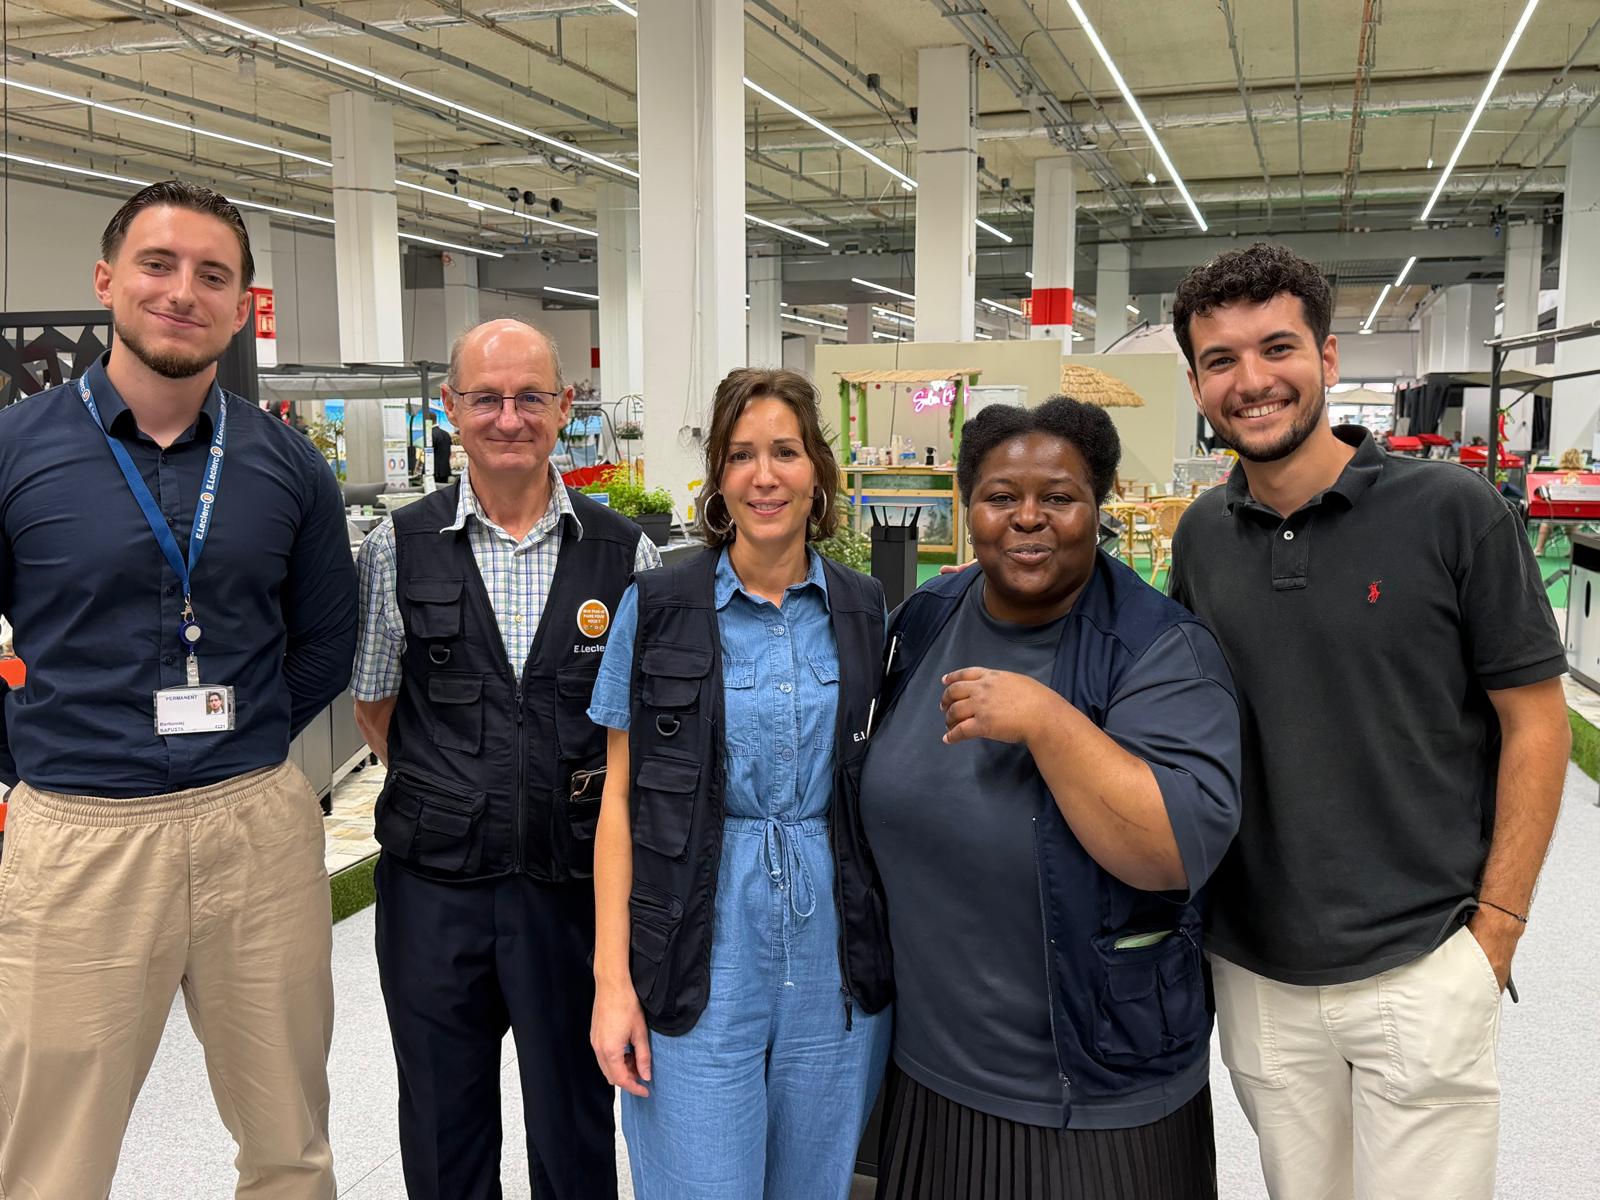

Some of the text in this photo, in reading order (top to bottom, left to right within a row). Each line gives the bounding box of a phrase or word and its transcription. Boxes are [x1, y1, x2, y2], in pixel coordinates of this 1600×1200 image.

[195, 502, 211, 540] E.Leclerc
[206, 456, 220, 490] E.Leclerc
[573, 644, 605, 653] E.Lecle
